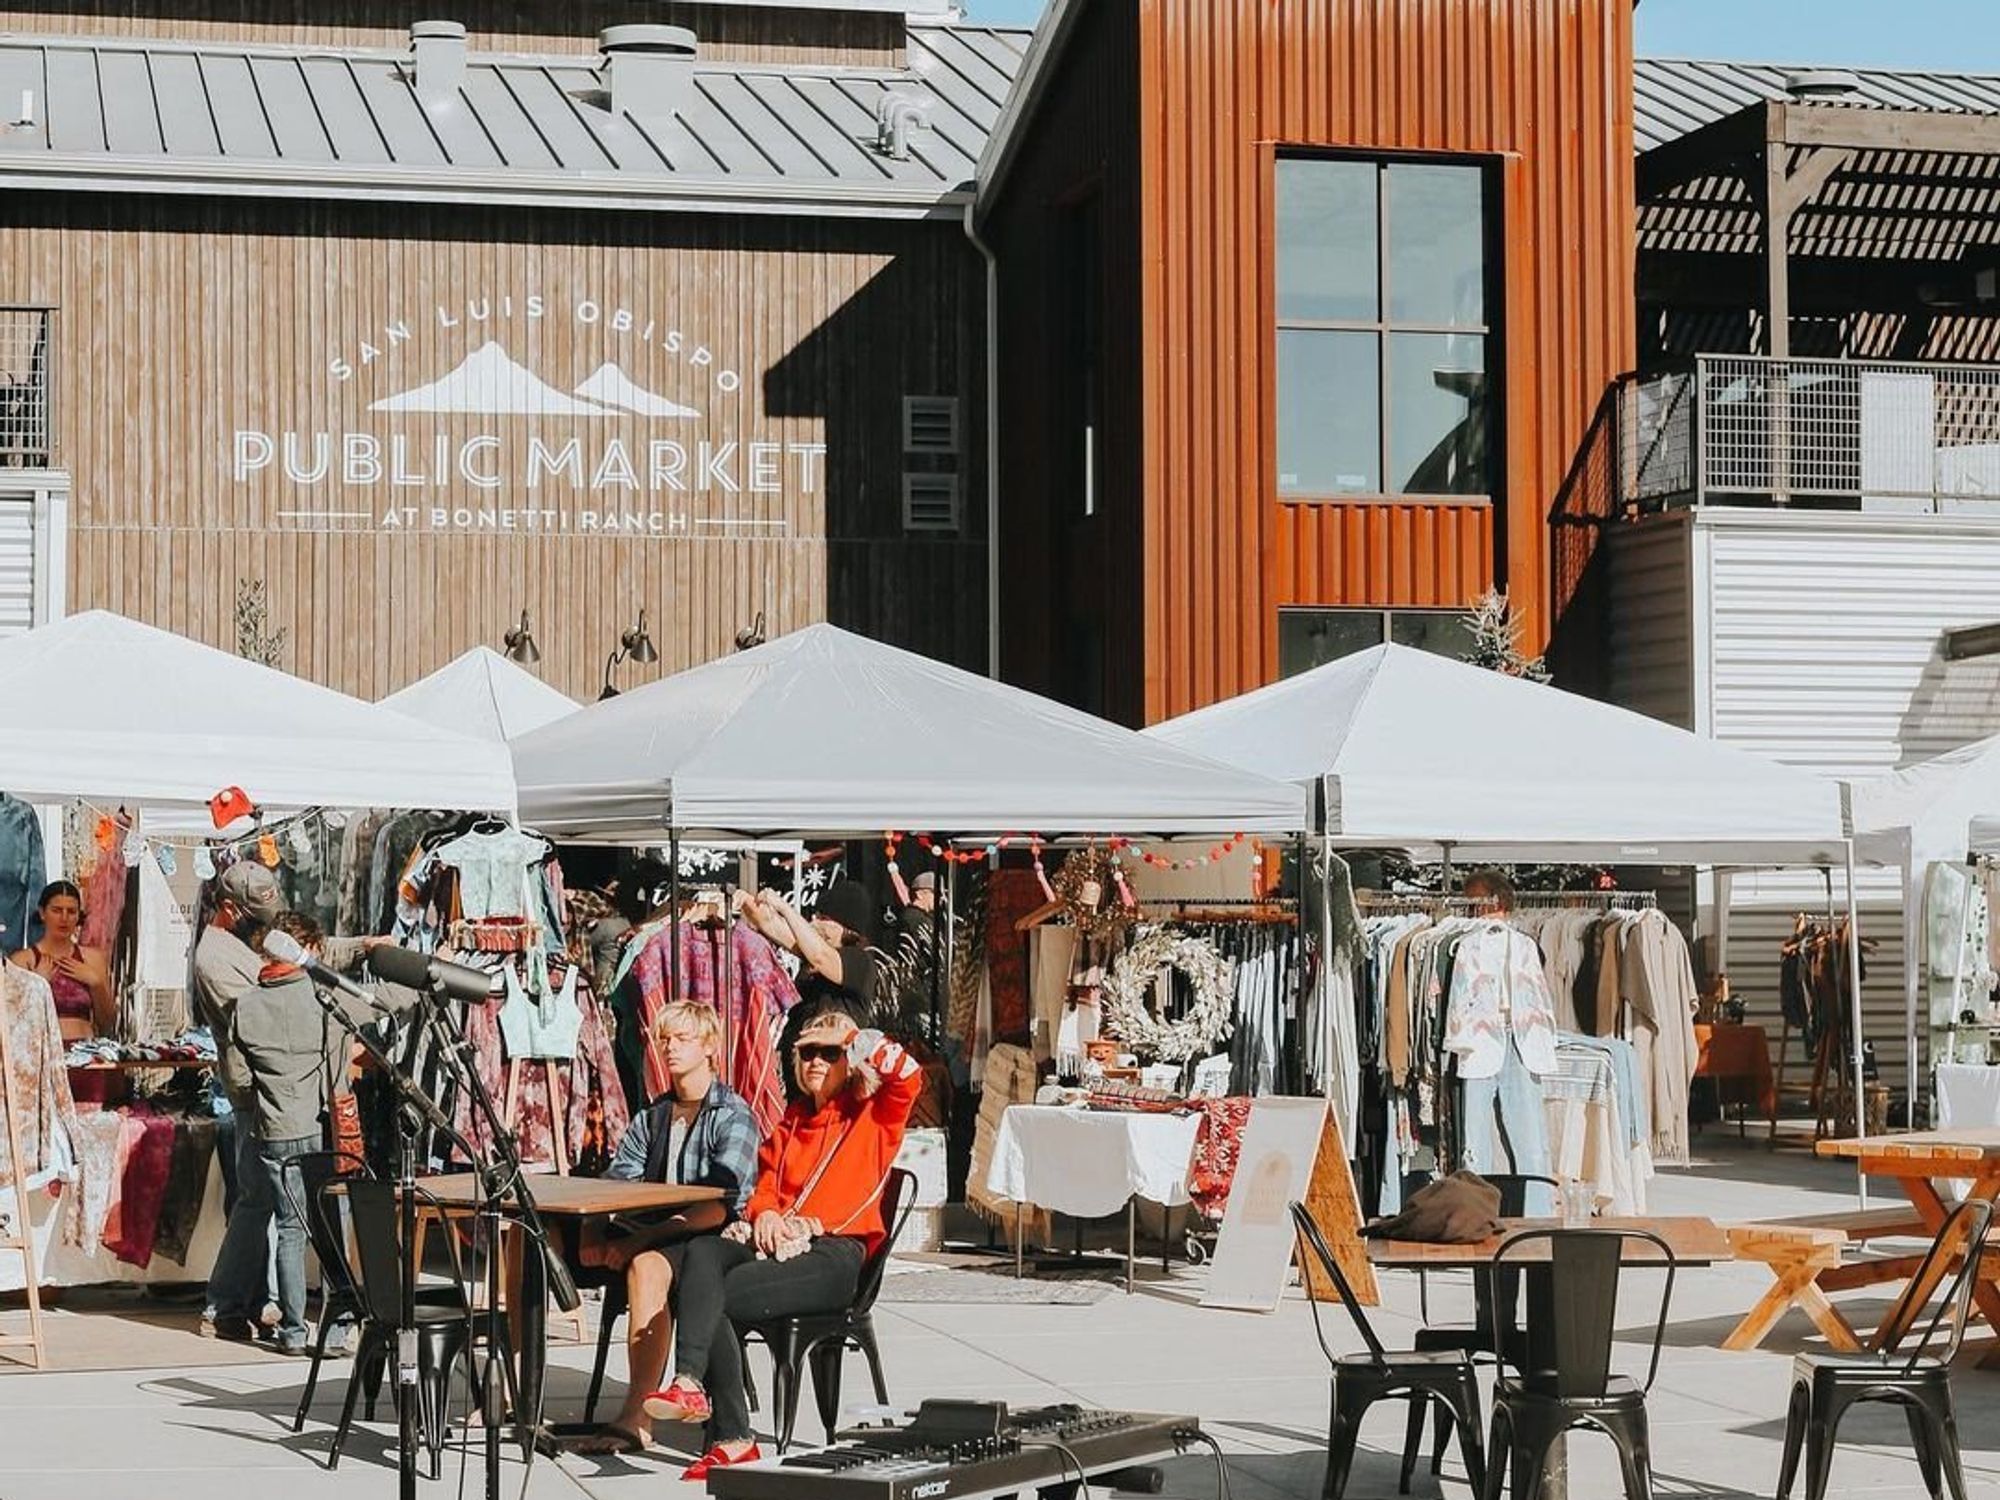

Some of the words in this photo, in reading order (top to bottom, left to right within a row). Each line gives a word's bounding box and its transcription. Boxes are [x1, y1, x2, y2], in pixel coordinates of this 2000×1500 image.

[329, 320, 411, 380] SAN
[438, 296, 544, 328] LUIS
[577, 301, 739, 392] OBISPO
[234, 431, 502, 488] PUBLIC
[527, 437, 828, 493] MARKET
[382, 507, 419, 526] AT
[432, 508, 567, 529] BONETTI
[581, 511, 687, 531] RANCH
